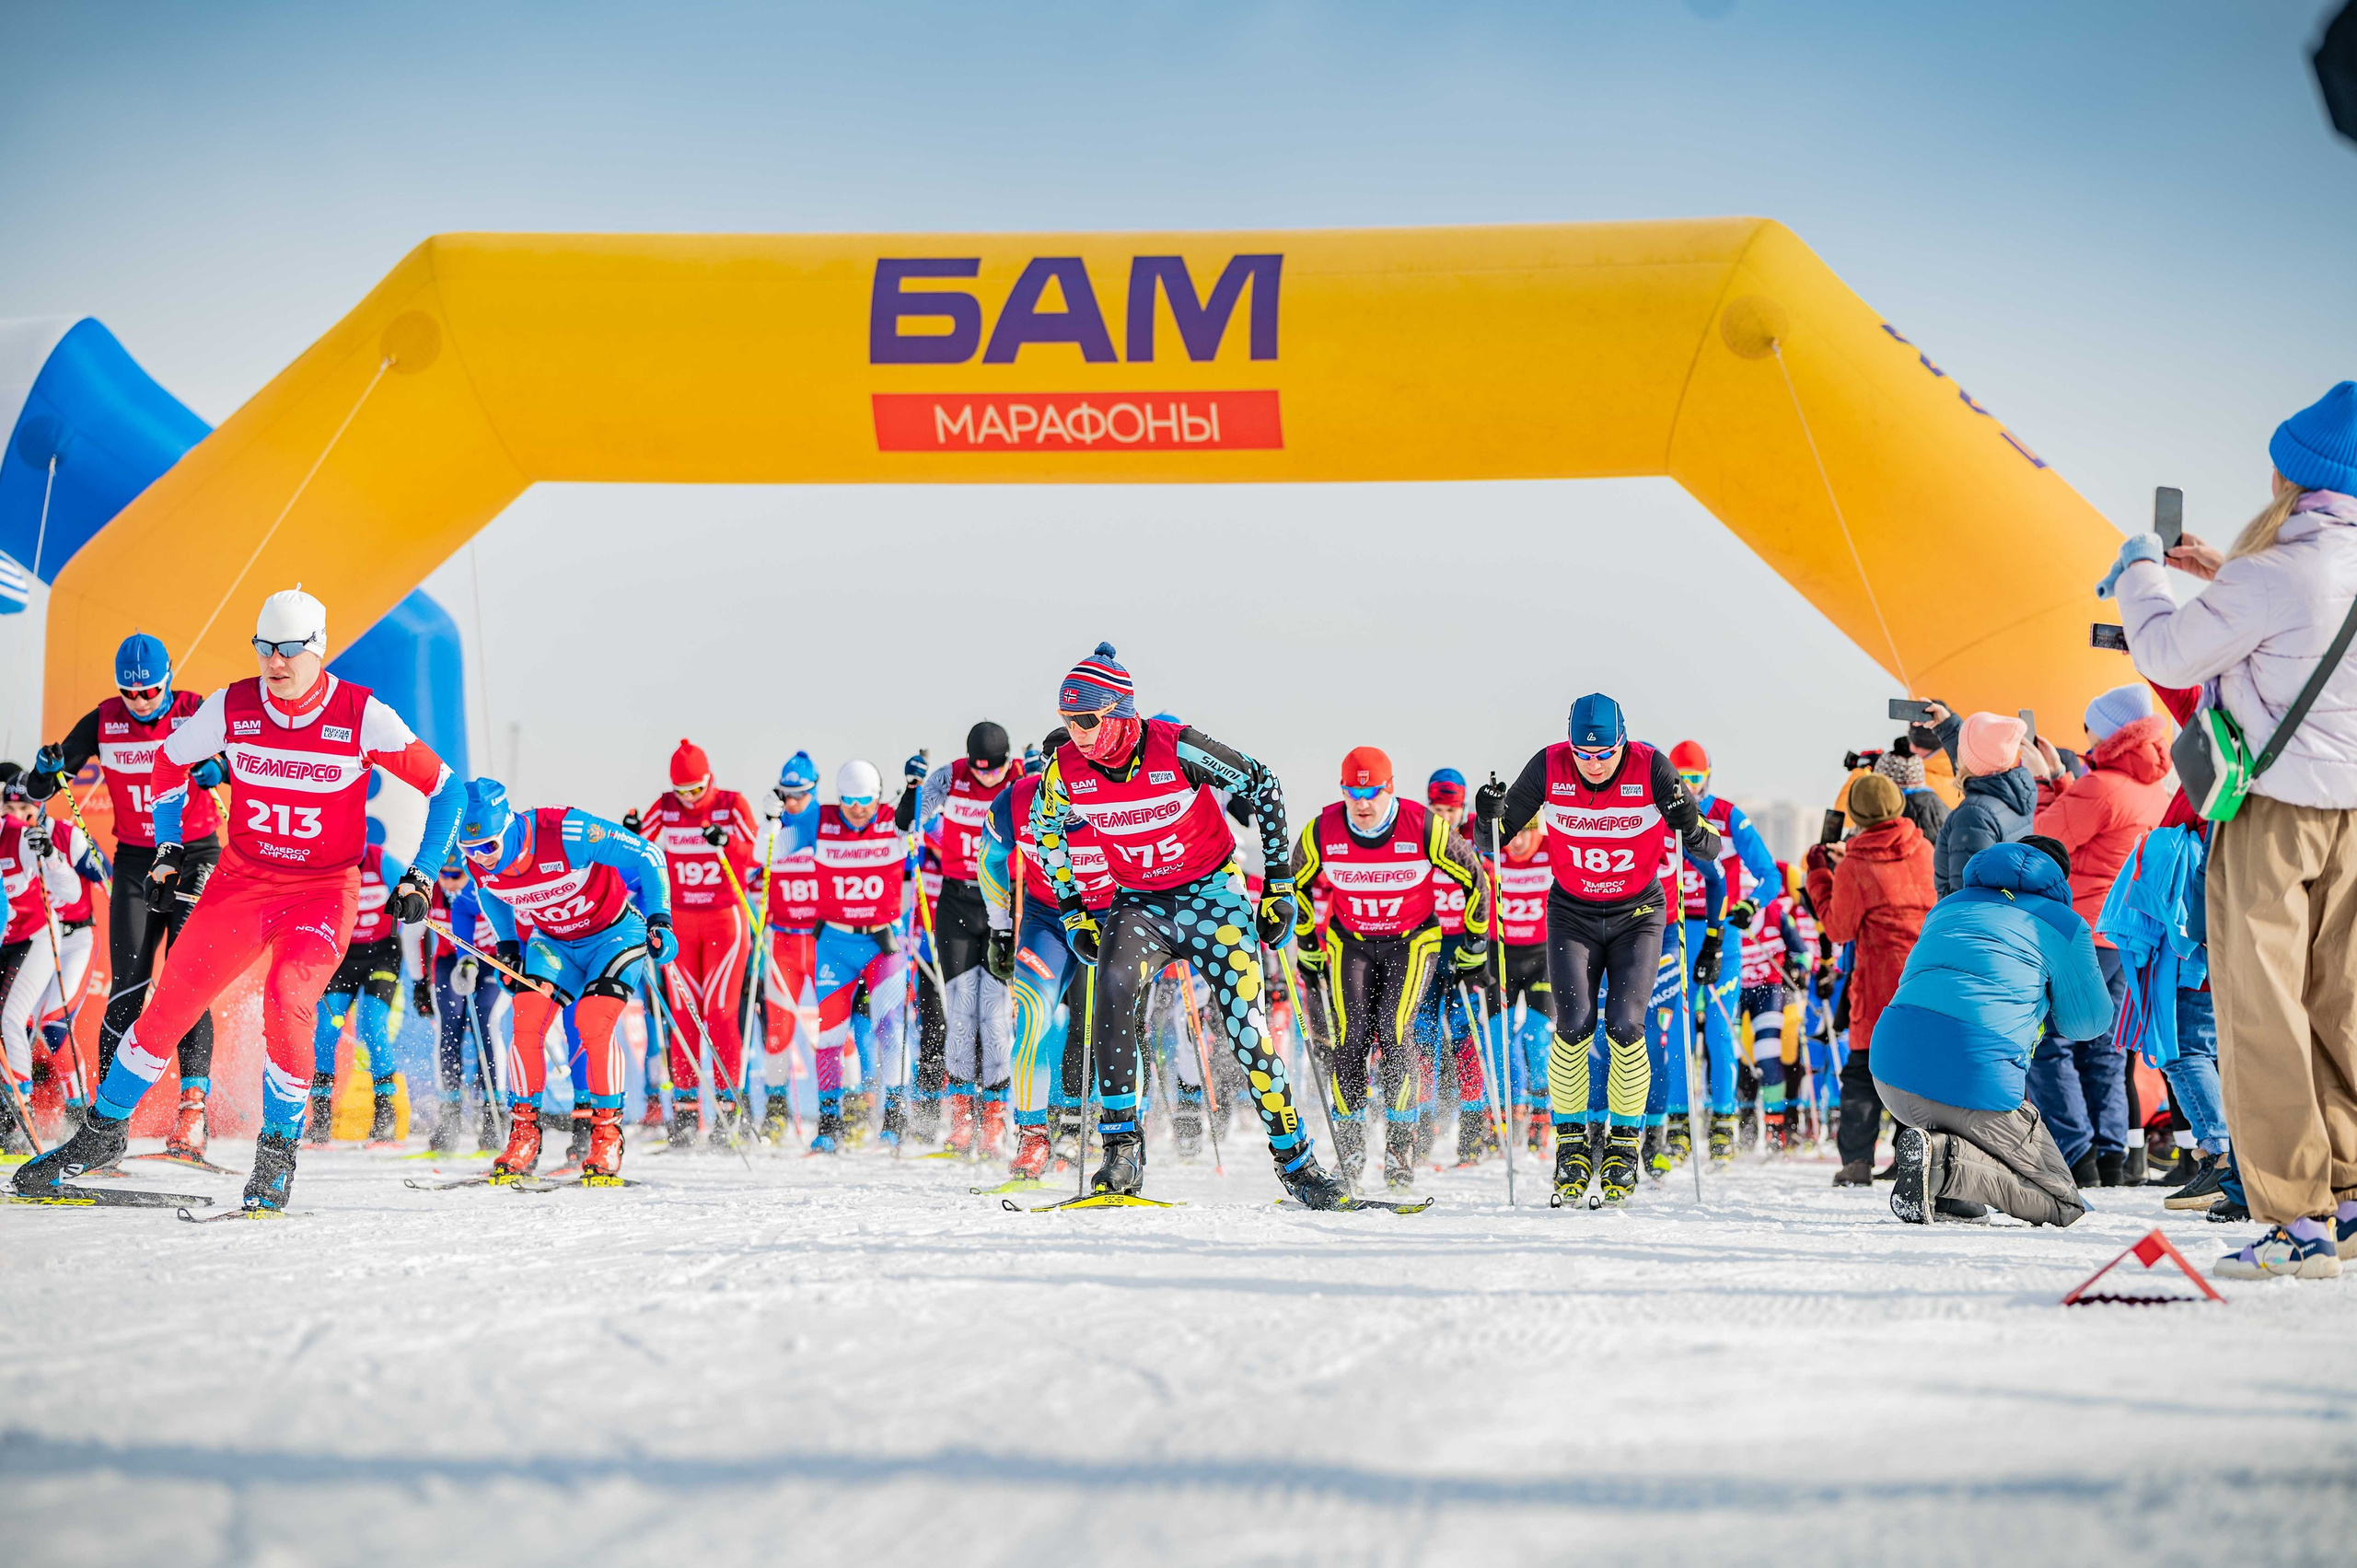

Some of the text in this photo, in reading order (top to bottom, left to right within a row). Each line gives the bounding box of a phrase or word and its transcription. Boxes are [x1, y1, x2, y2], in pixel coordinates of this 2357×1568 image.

[870, 253, 1283, 365] БАМ
[934, 401, 1221, 445] МАРАФОНЫ
[124, 669, 150, 682] DNB
[298, 685, 324, 710] NORDSK
[233, 720, 261, 730] БАМ
[1201, 755, 1242, 781] SILVINI
[1551, 783, 1576, 791] БАМ
[246, 798, 322, 839] 213
[442, 807, 462, 855] NORDSKI
[260, 849, 306, 862] АНГАРА
[1113, 833, 1186, 868] 175
[1567, 844, 1635, 873] 182
[675, 860, 722, 886] 192
[778, 878, 819, 902] 181
[832, 875, 885, 900] 120
[1583, 886, 1622, 894] АНГАРА
[1348, 896, 1404, 917] 117
[1503, 897, 1544, 922] 223
